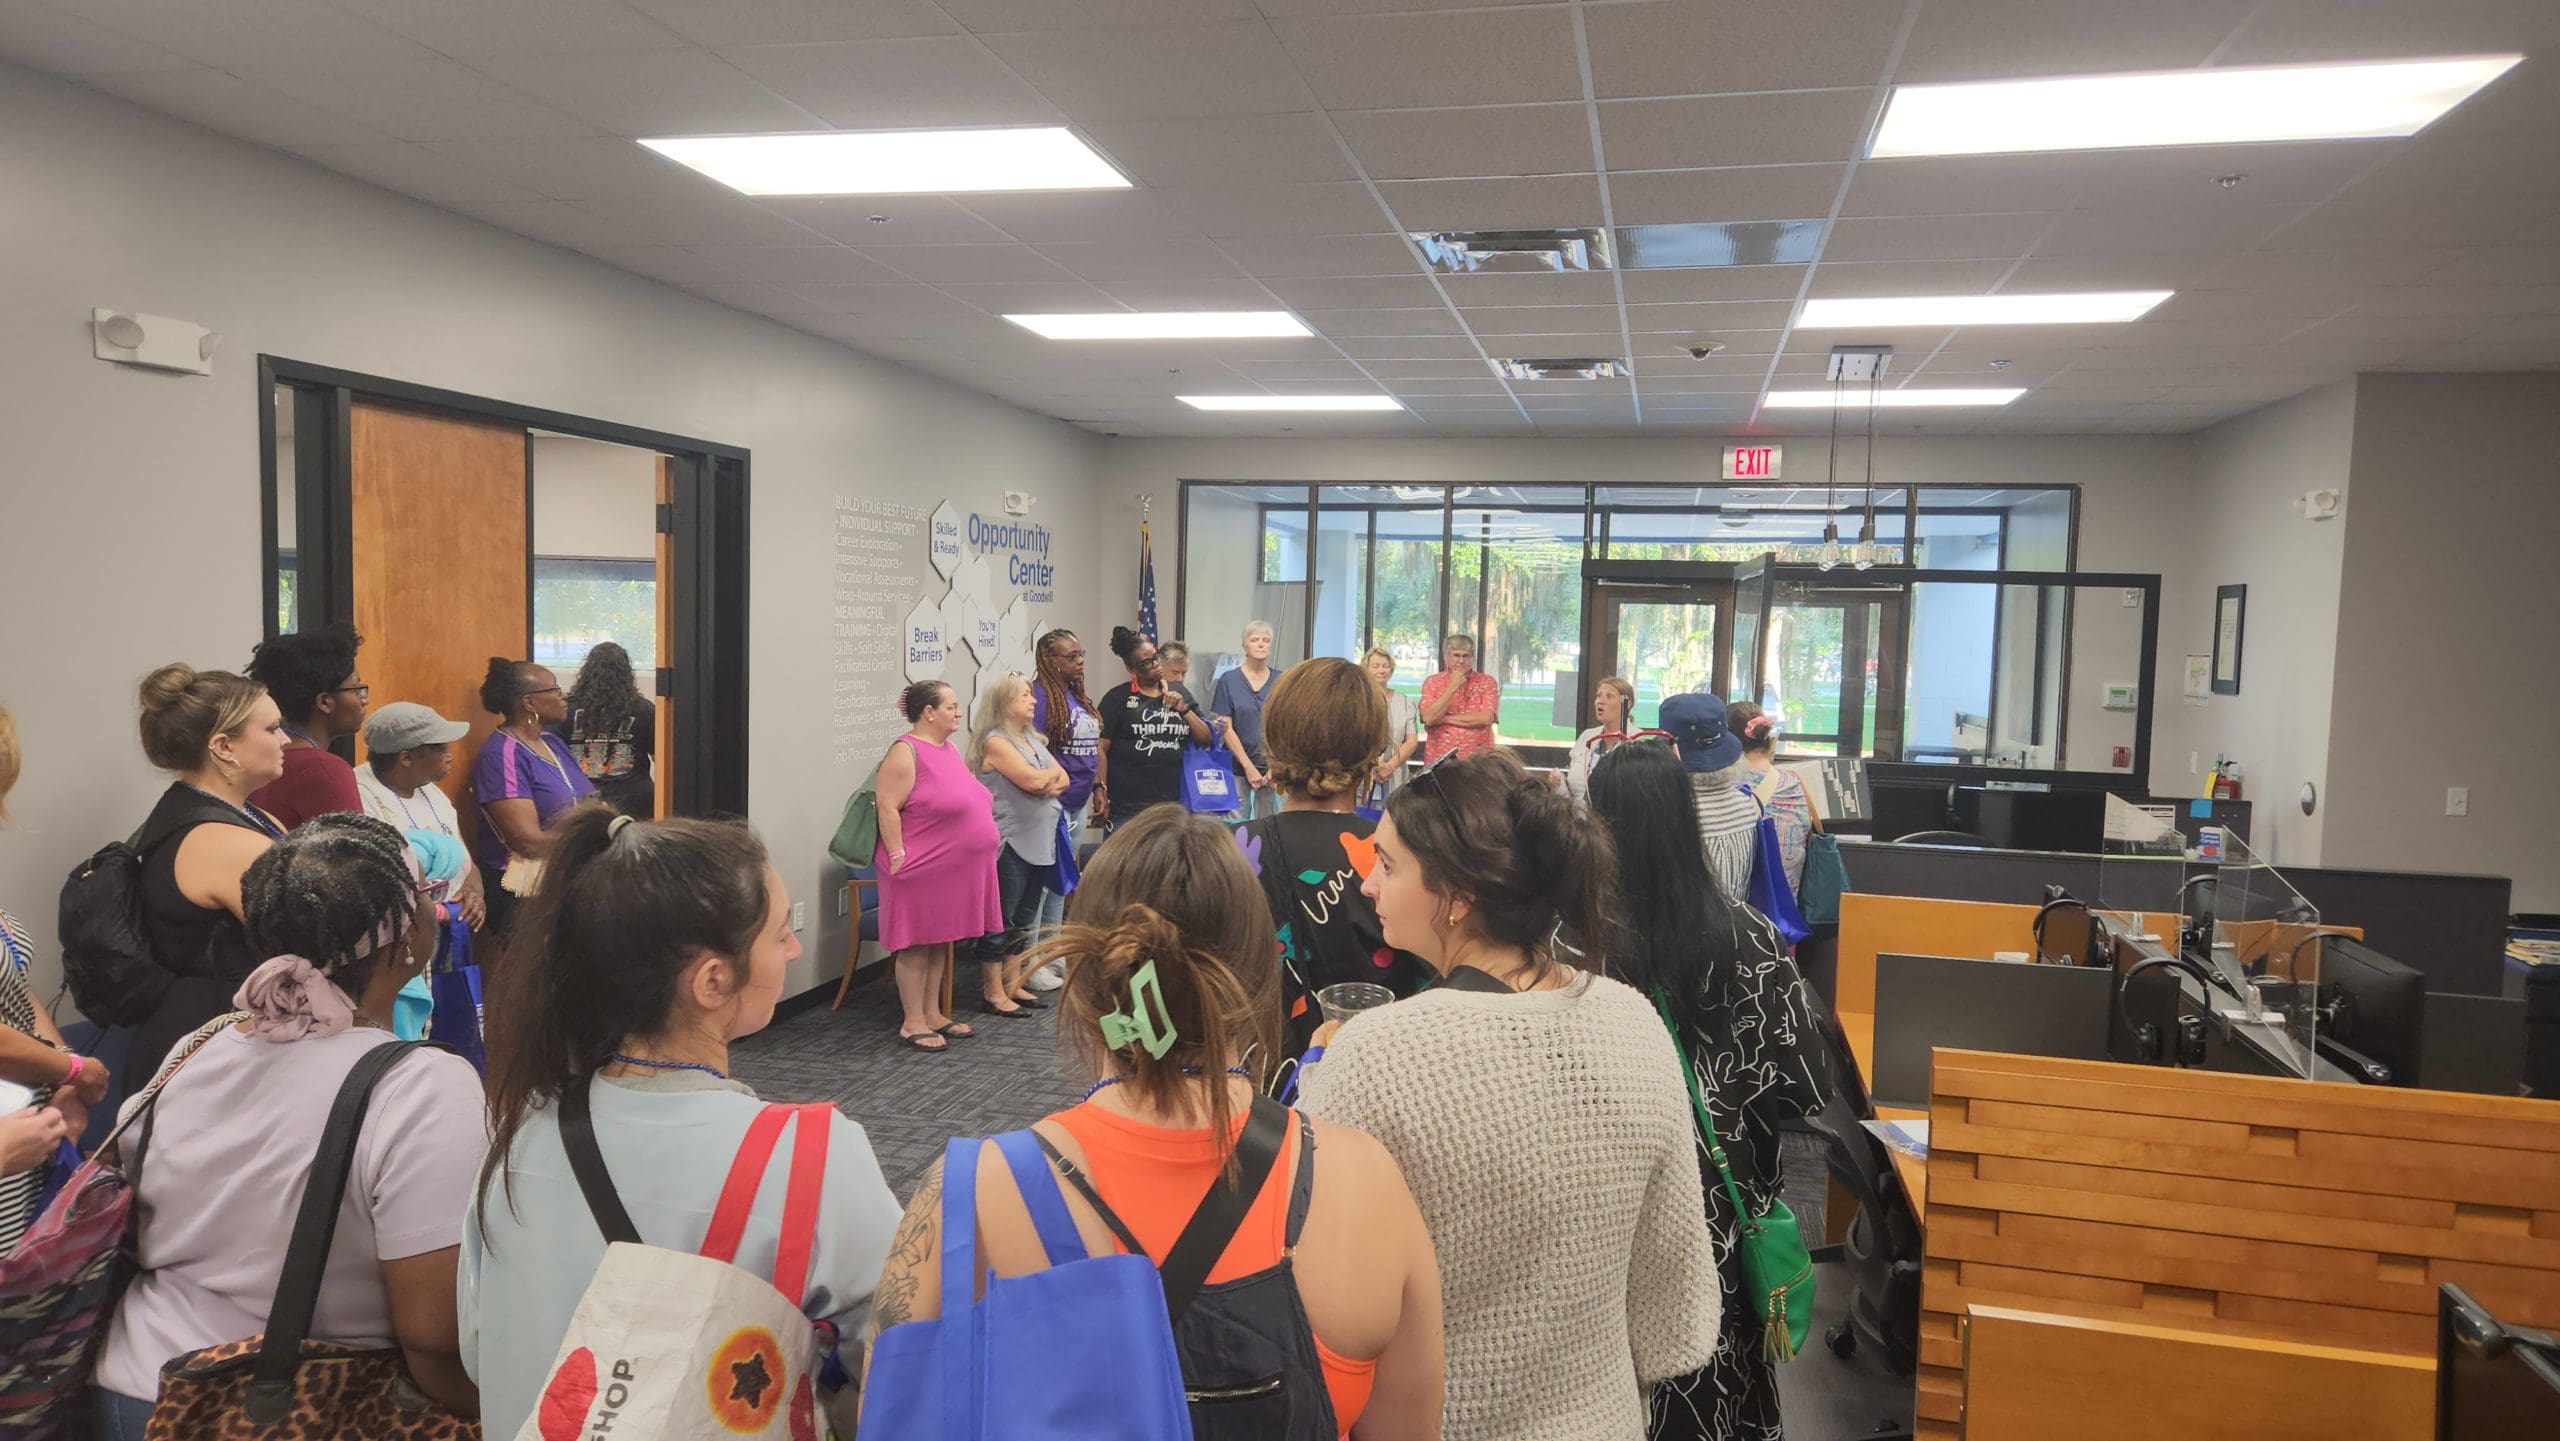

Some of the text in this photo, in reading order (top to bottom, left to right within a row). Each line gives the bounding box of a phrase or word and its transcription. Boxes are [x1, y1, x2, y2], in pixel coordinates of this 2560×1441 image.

[1735, 448, 1772, 475] EXIT
[835, 495, 928, 521] BUILD YOUR BEST FUTURE
[840, 515, 916, 537] INDIVIDUAL SUPPORT
[935, 521, 957, 536] Skilled
[835, 532, 899, 552] Career Exploration
[968, 513, 1050, 560] Opportunity
[934, 541, 960, 558] & Ready
[835, 552, 900, 569] Intensive Supports
[835, 569, 915, 586] Vocational Assessments
[1009, 553, 1054, 587] Center
[1029, 590, 1054, 602] Goodwill
[835, 605, 884, 620] MEANINGFUL
[834, 623, 872, 638] TRAINING
[978, 619, 996, 631] You're
[914, 627, 939, 643] Break
[834, 640, 853, 655] Skills
[910, 647, 943, 663] Barriers
[834, 679, 866, 693] Learning
[591, 1359, 634, 1441] HOP
